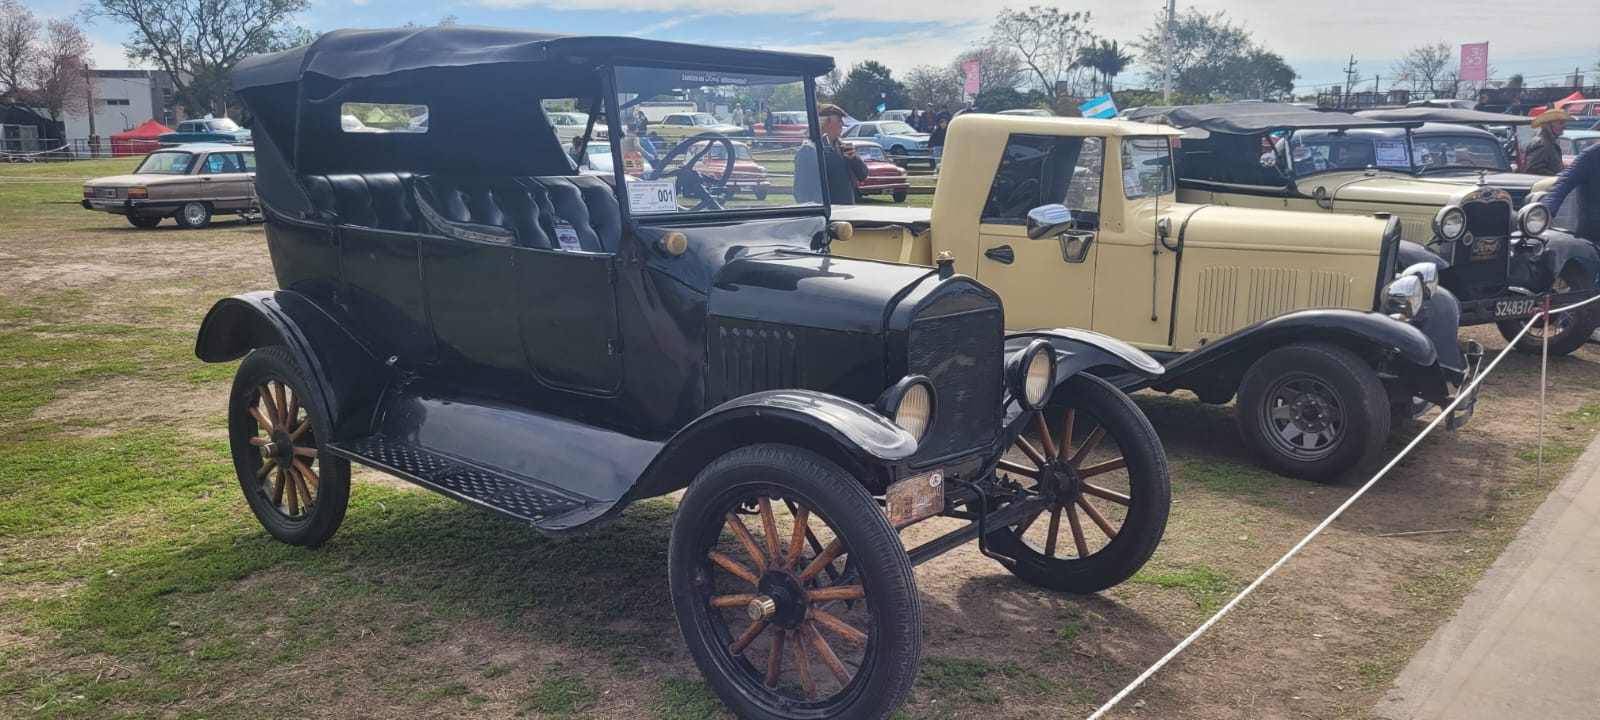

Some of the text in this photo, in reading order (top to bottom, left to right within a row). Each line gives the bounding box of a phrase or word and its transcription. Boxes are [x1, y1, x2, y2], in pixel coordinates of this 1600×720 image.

[658, 190, 673, 202] 001
[1472, 239, 1498, 254] Ford
[1495, 299, 1535, 316] S248317
